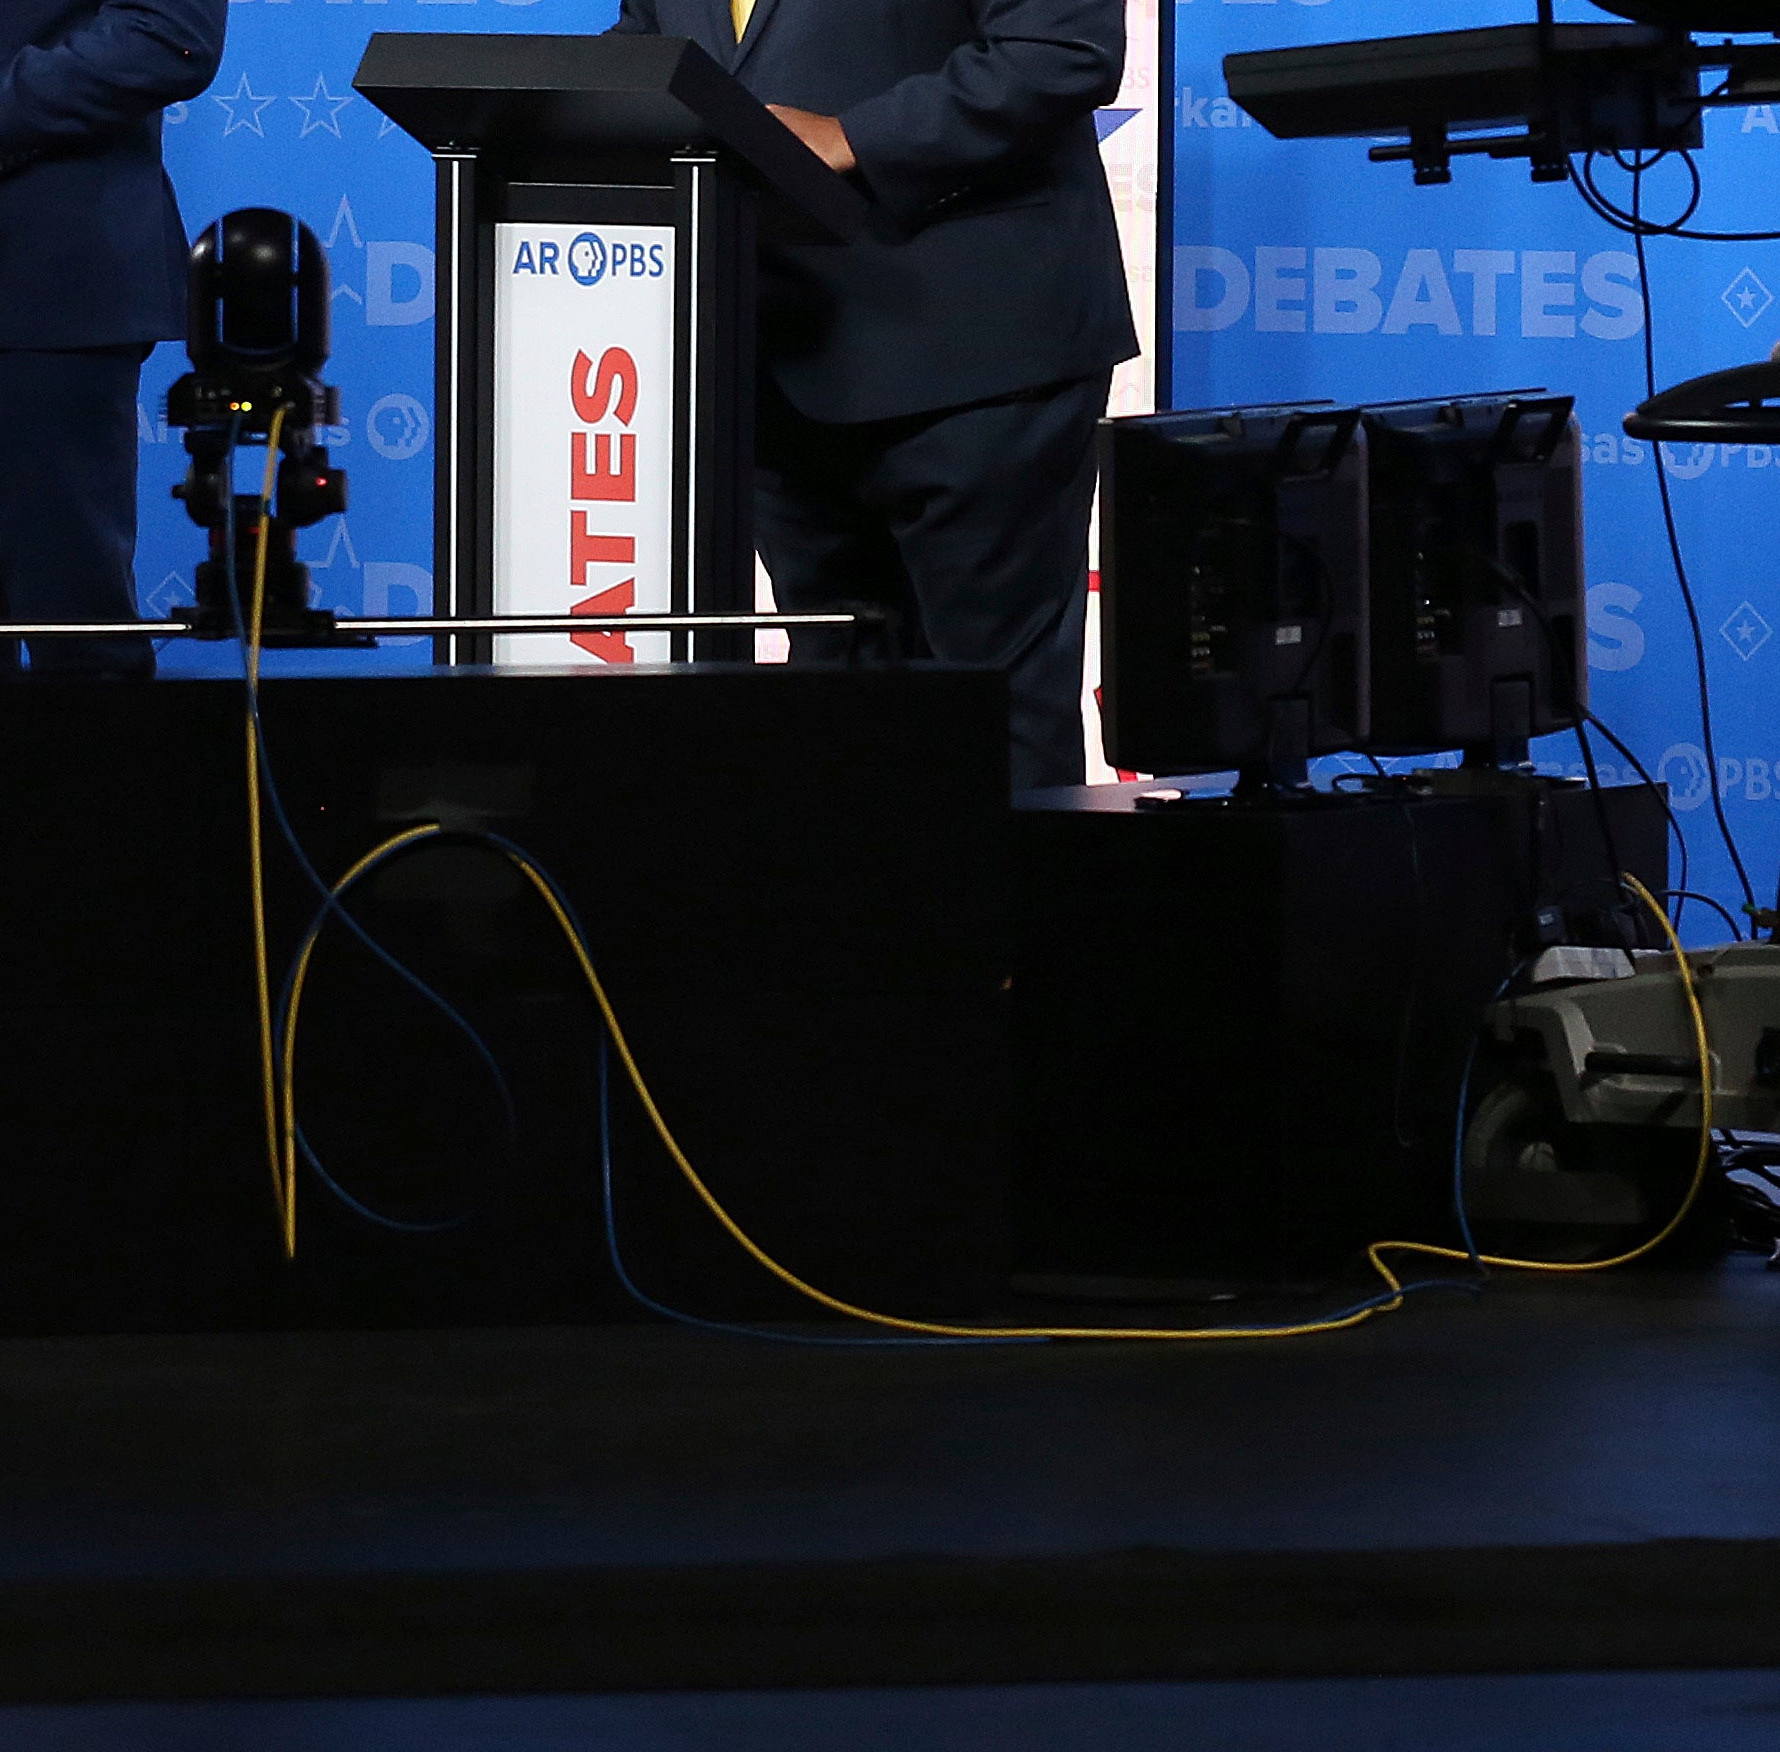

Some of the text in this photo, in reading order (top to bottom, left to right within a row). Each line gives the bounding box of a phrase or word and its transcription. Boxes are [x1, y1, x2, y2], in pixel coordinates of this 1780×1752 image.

[512, 240, 665, 278] AR PBS
[1175, 246, 1646, 340] DEBATES
[570, 345, 640, 664] ATES
